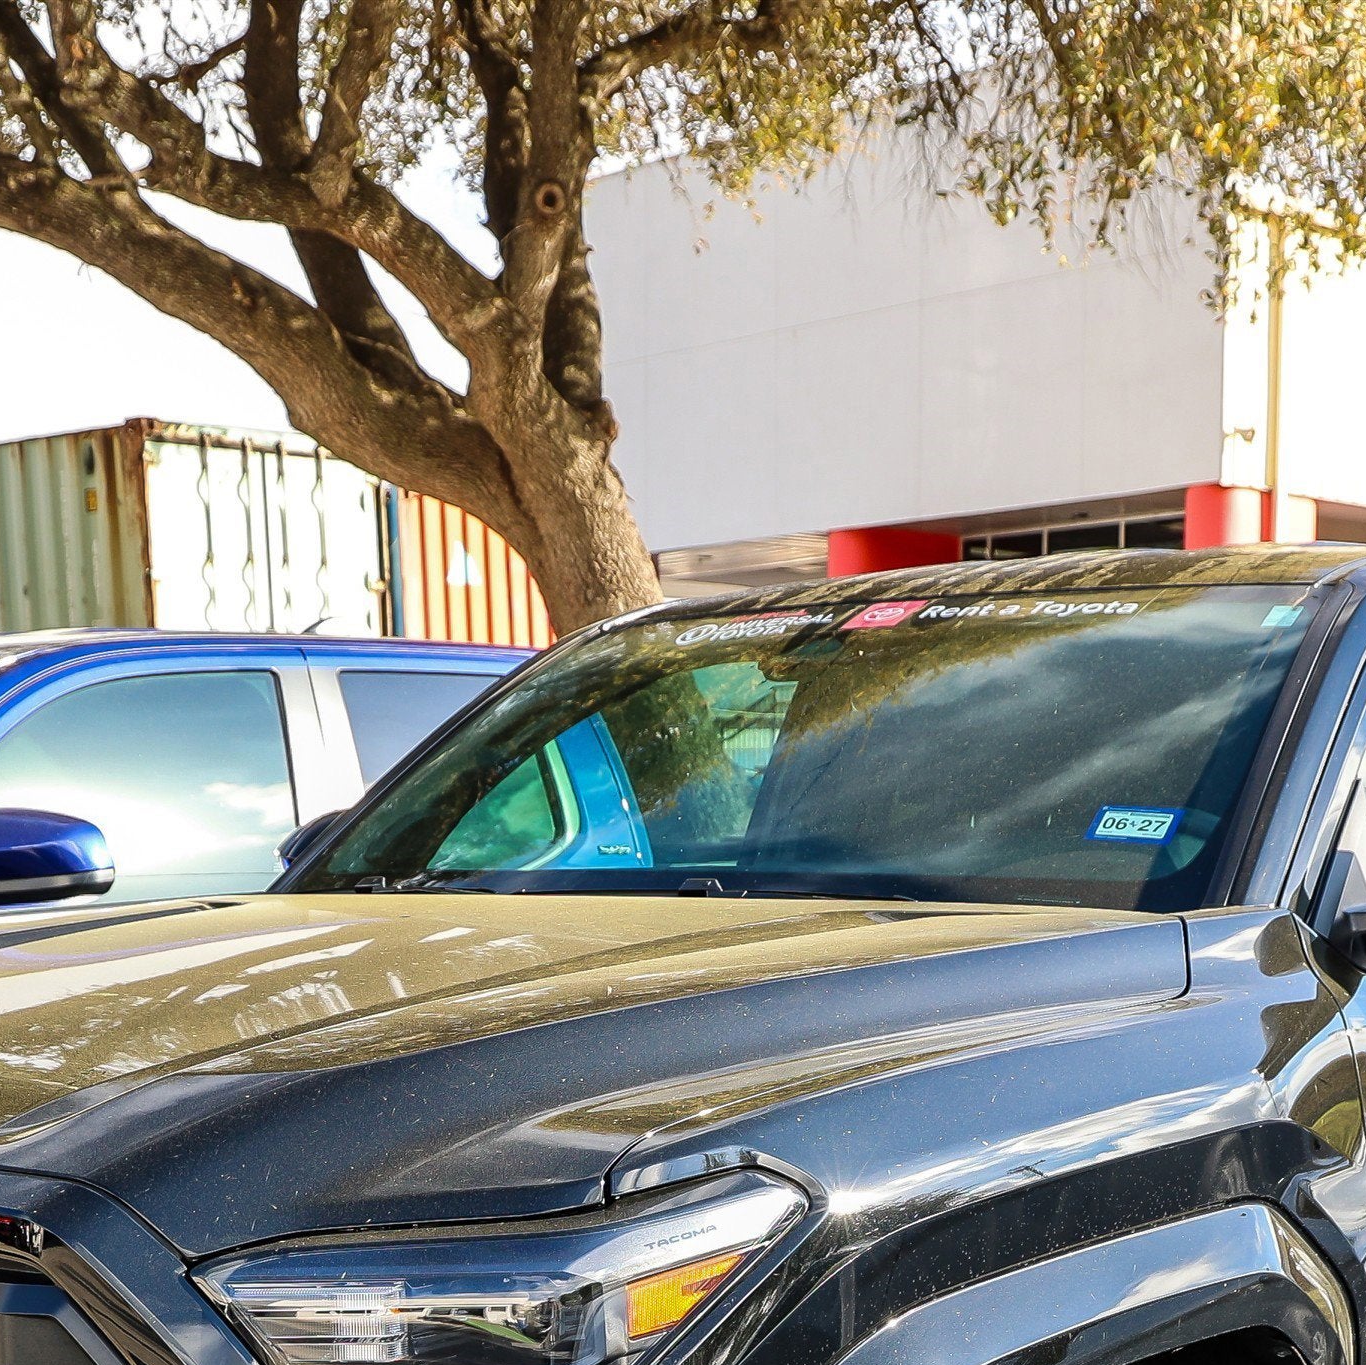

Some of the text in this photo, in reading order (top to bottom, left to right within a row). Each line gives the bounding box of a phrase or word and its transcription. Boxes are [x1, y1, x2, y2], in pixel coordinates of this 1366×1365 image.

[919, 600, 1139, 620] Rent a Toyota
[717, 613, 834, 632] UNIVERSAL
[709, 625, 787, 642] TOYOTA
[1102, 817, 1167, 832] 06 27
[644, 1225, 717, 1250] TACOMA
